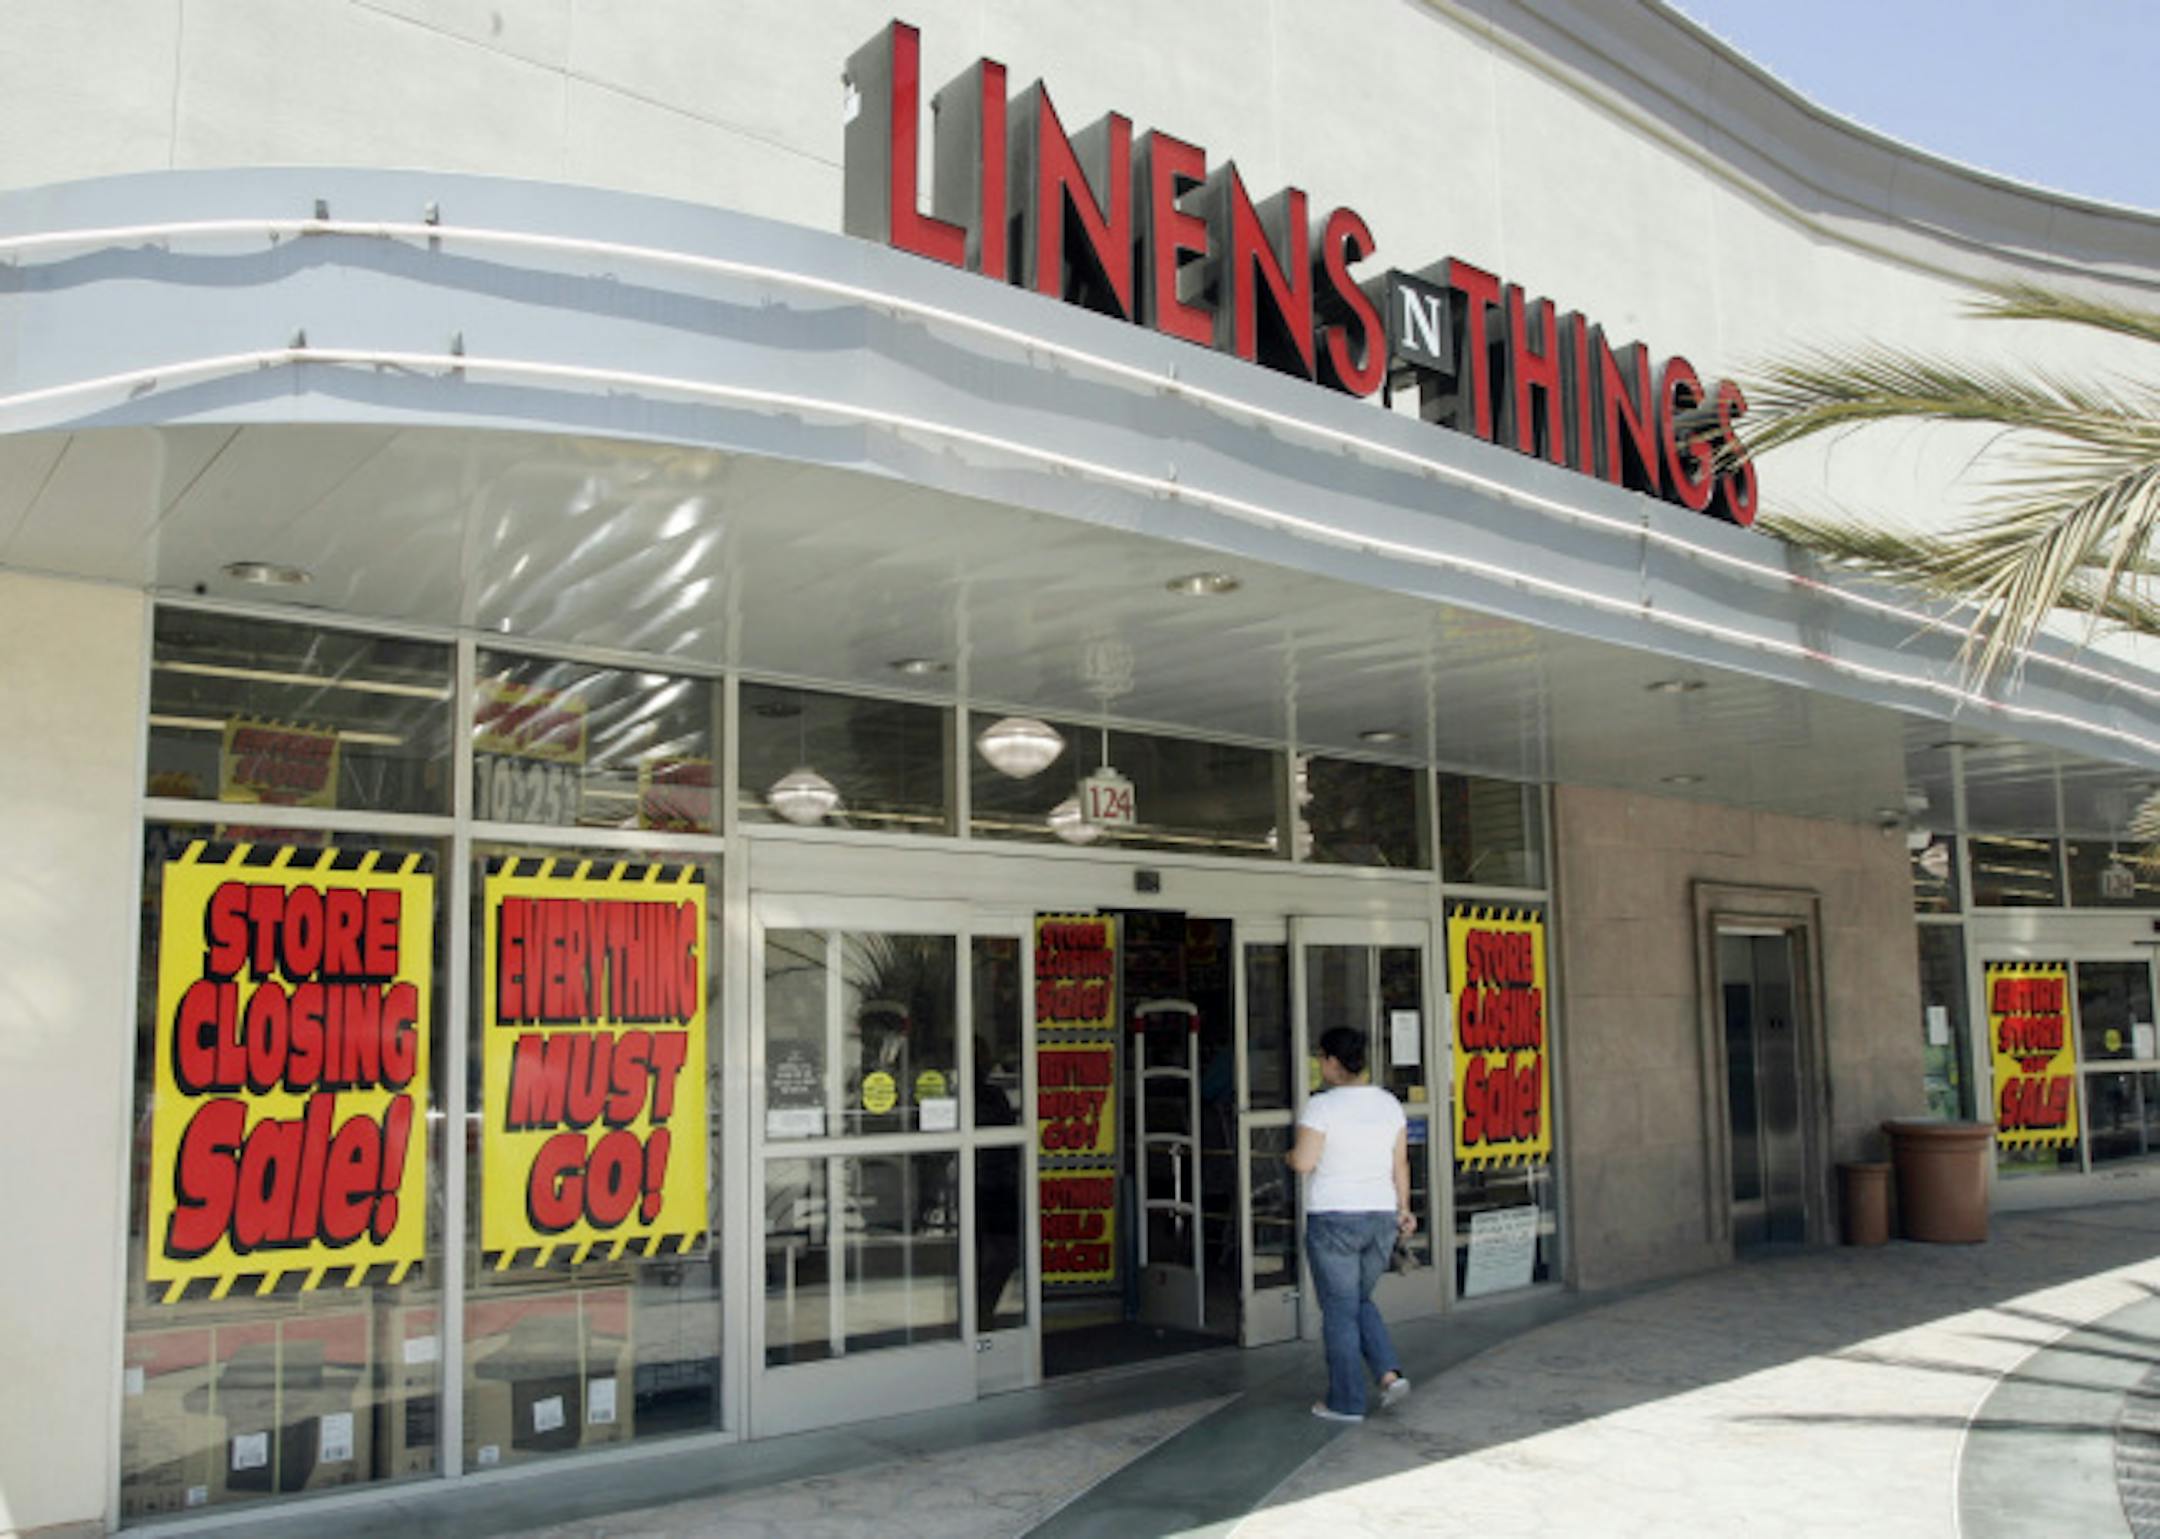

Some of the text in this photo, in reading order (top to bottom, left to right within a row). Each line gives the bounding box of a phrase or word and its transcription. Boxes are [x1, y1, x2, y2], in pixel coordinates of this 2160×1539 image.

[888, 20, 1758, 528] LINENS N THINGS
[1088, 786, 1133, 822] 124
[203, 881, 402, 985] STORE
[496, 895, 699, 1026] EVERYTHING
[1464, 927, 1534, 988] STORE
[171, 978, 419, 1097] CLOSING
[1458, 984, 1542, 1054] CLOSING
[1998, 1015, 2064, 1053] STORE
[505, 1029, 689, 1132] MUST
[1461, 1051, 1543, 1147] Sale!
[2000, 1075, 2072, 1132] SALE
[163, 1092, 415, 1261] Sale!
[525, 1126, 672, 1235] GO!
